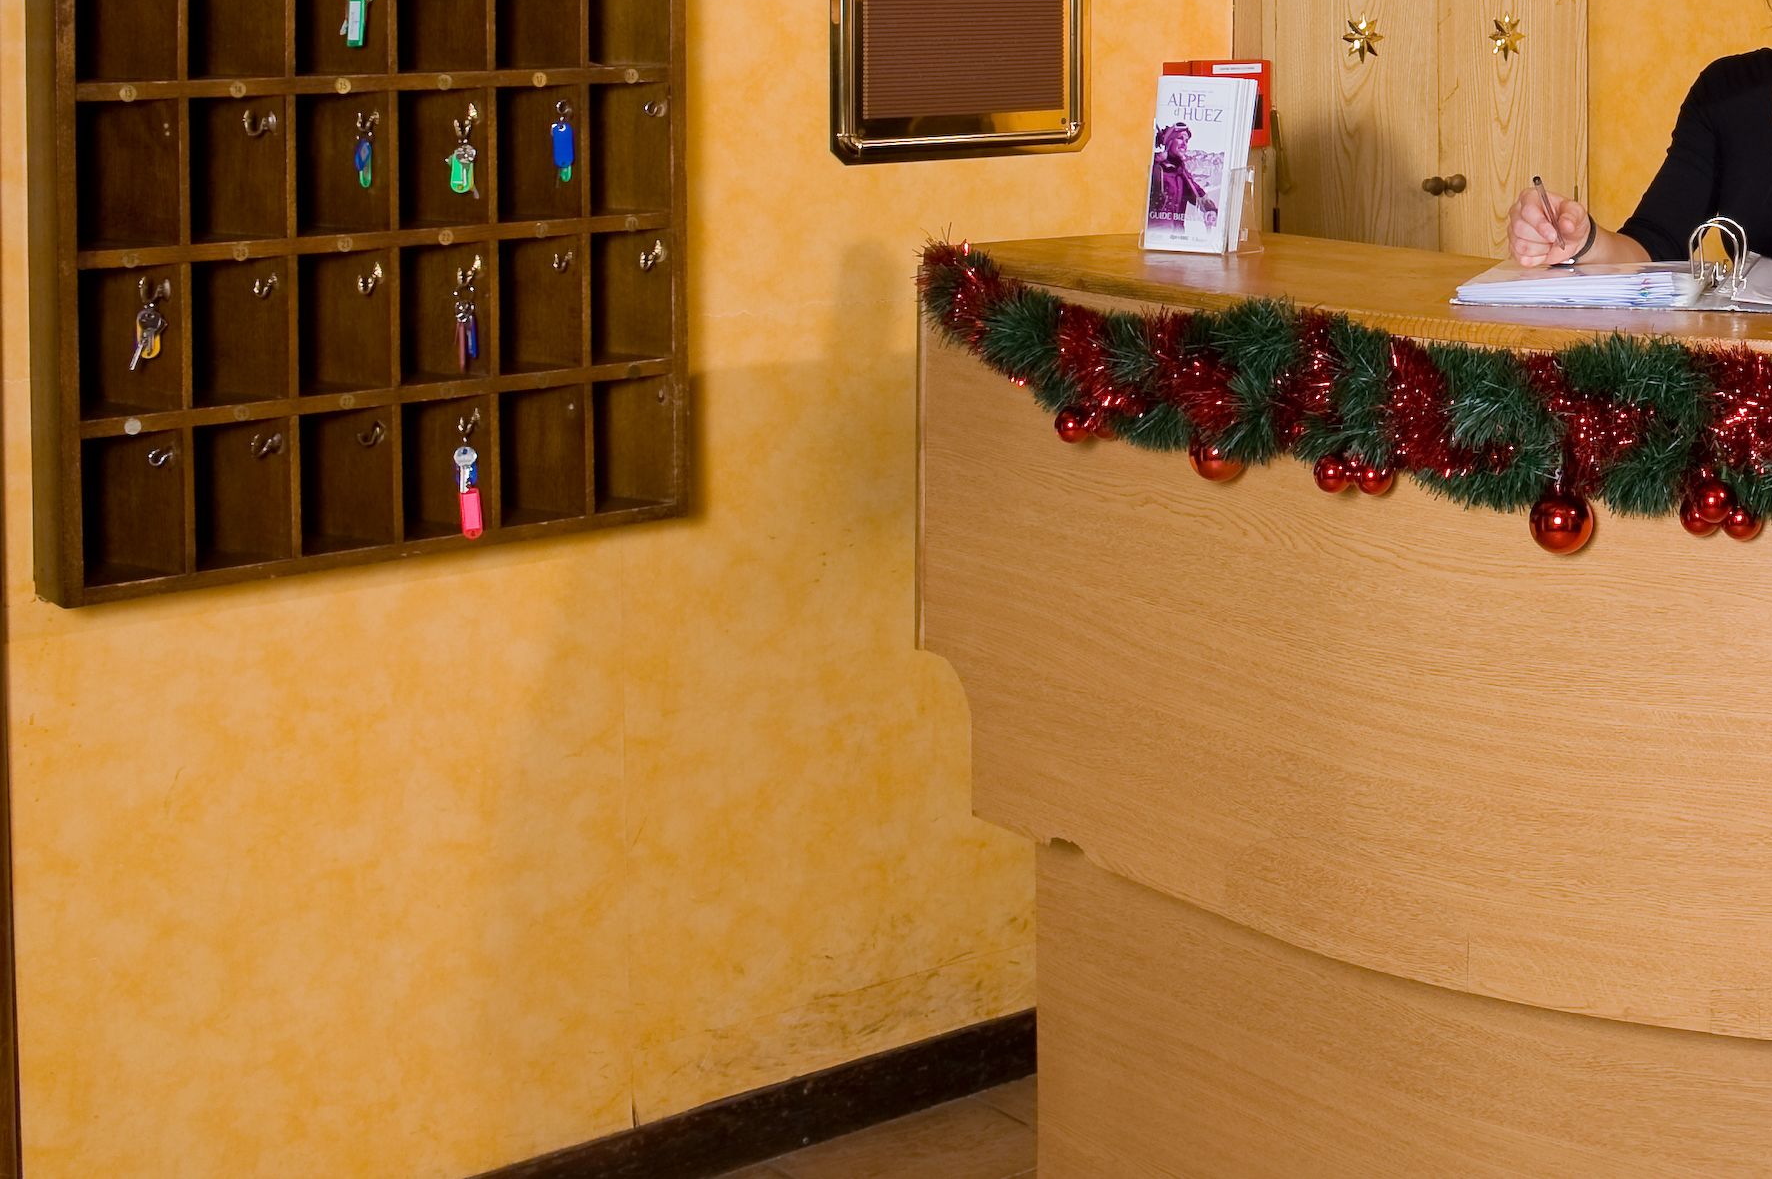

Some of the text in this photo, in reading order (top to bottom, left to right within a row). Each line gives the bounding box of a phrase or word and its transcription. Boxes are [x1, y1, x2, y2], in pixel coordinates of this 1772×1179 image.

[536, 75, 543, 84] 17
[339, 81, 347, 91] 15
[1167, 92, 1207, 108] ALPE
[1149, 210, 1172, 221] GUIDE
